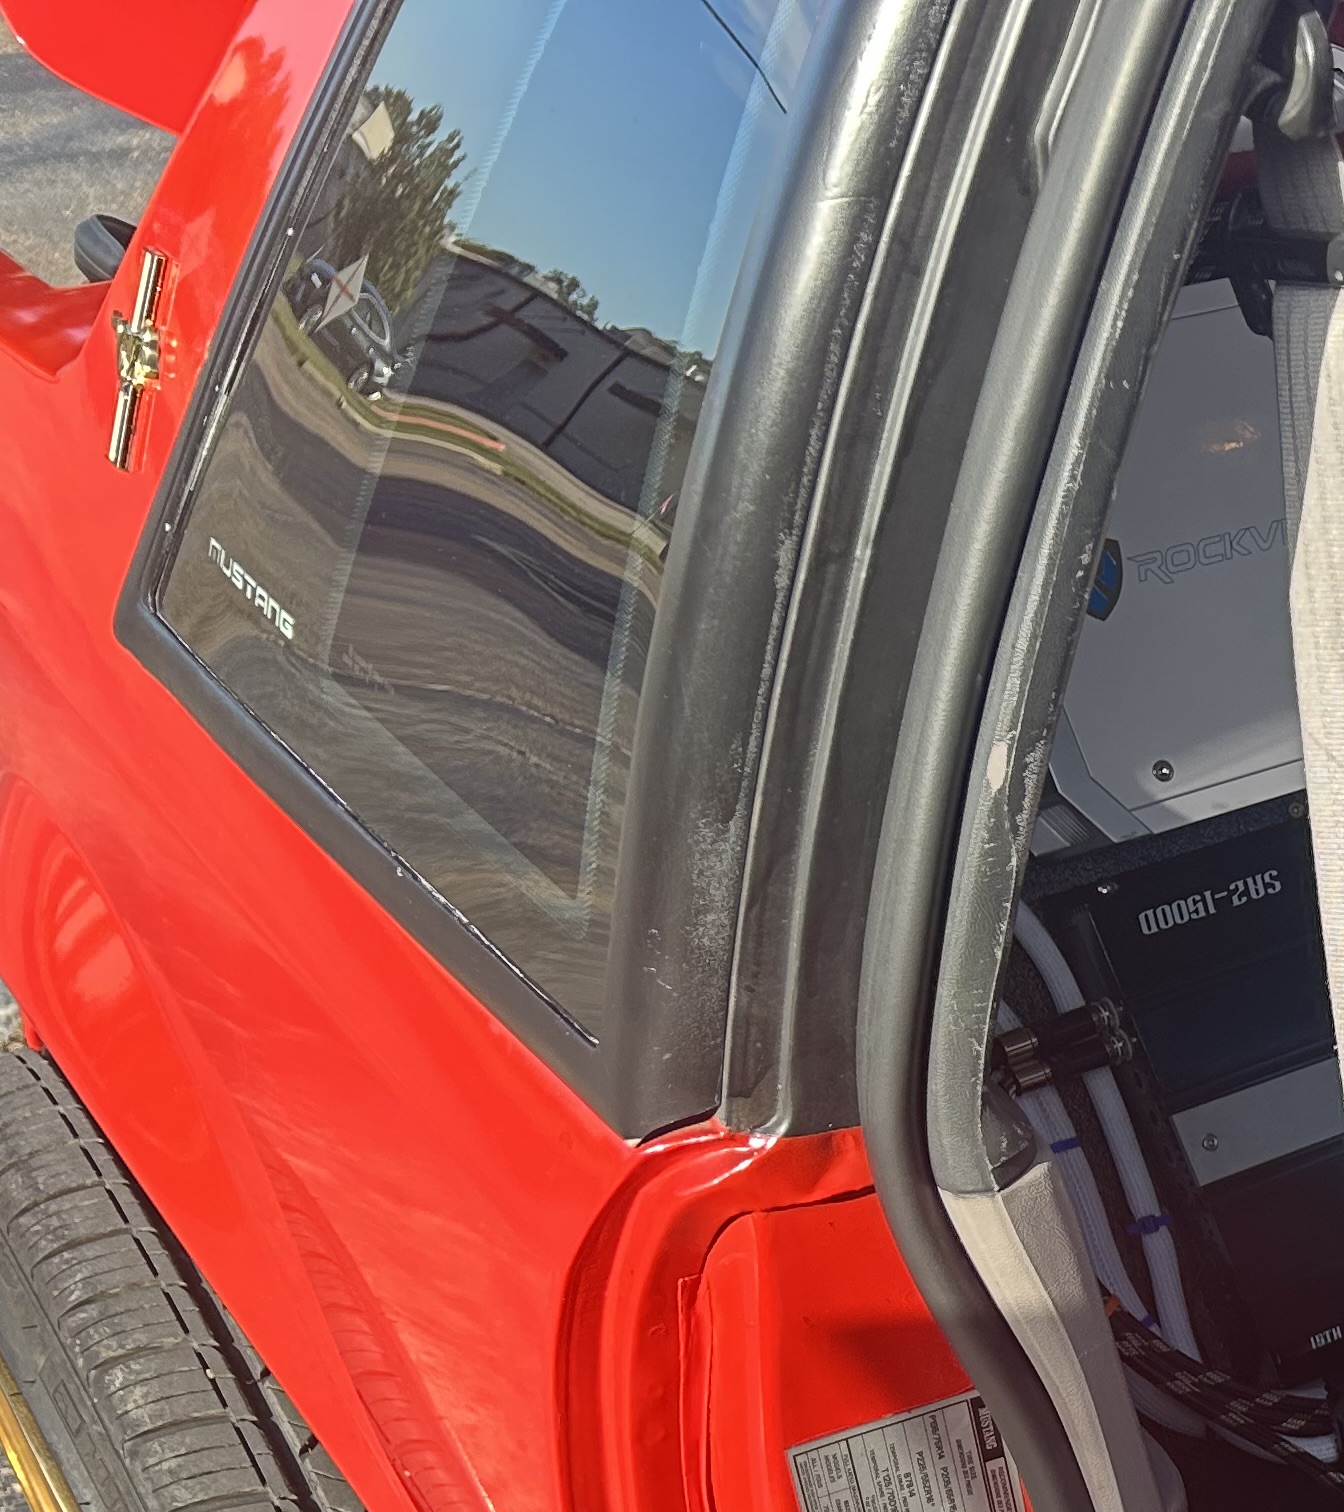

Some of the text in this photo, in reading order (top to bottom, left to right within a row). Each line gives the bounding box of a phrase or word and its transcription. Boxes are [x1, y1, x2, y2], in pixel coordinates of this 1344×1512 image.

[1127, 519, 1287, 584] ROCKVI
[208, 536, 295, 641] MUSTANG
[975, 1405, 998, 1450] MUSTANG
